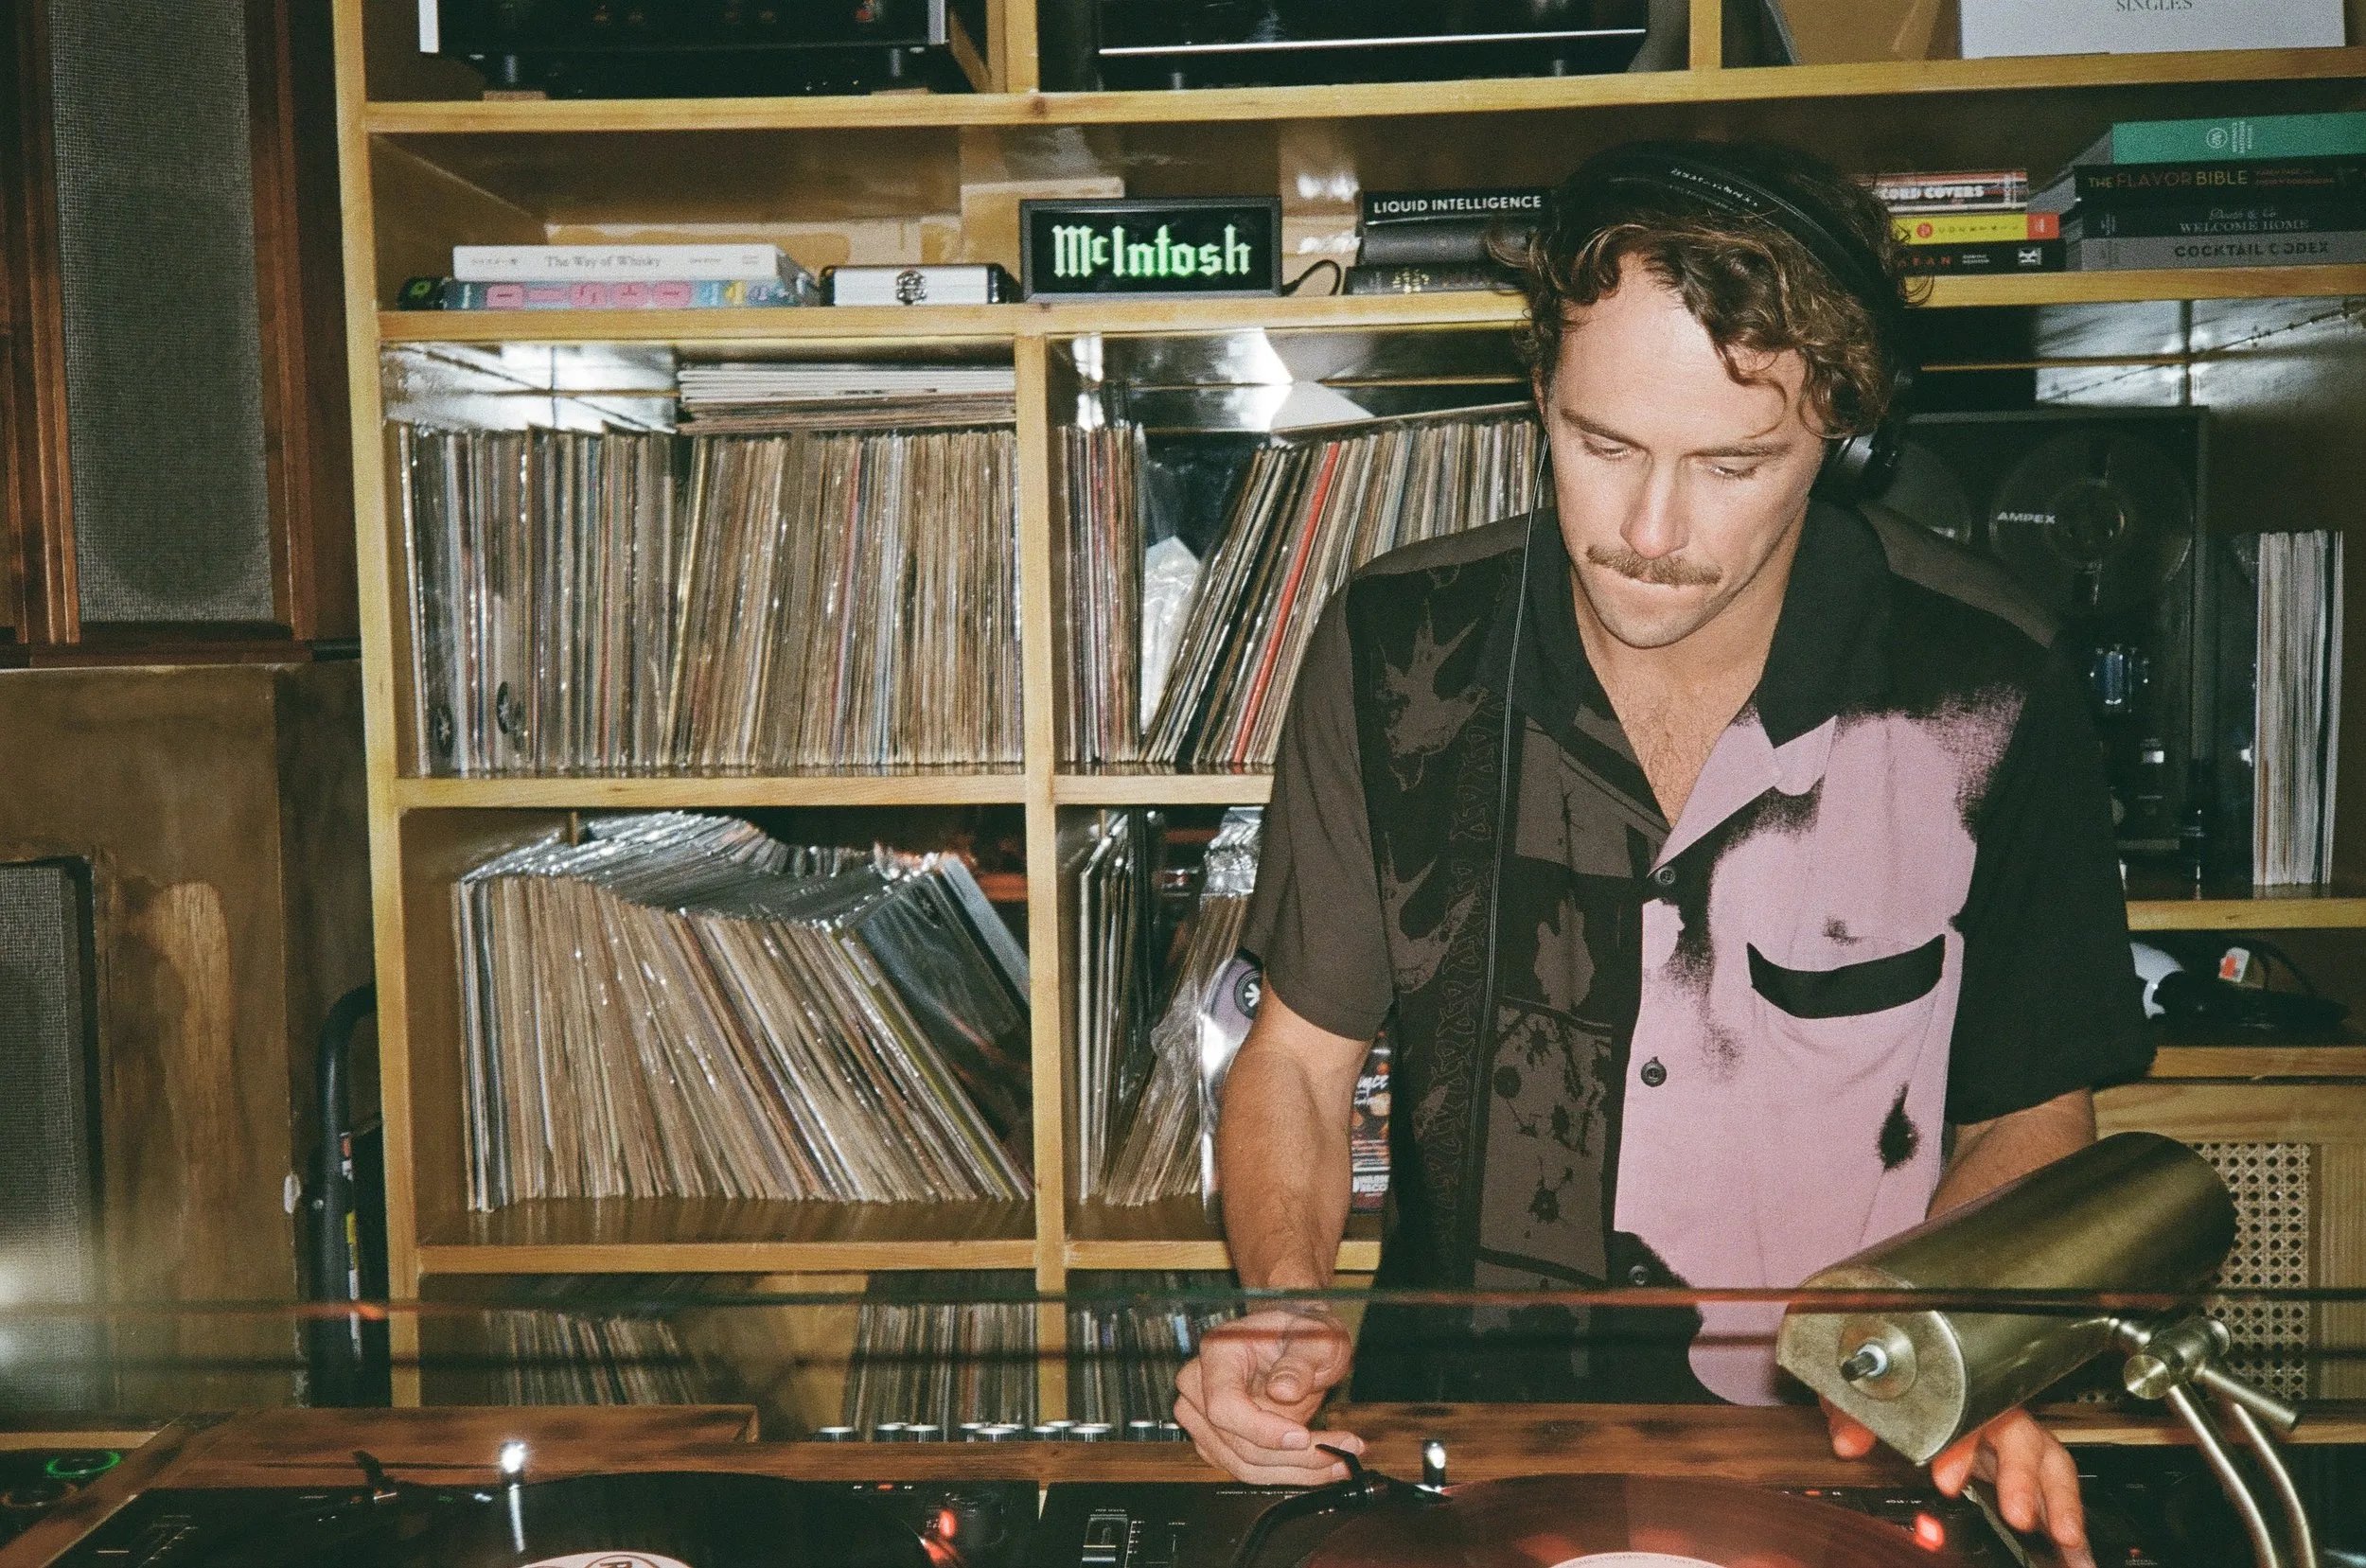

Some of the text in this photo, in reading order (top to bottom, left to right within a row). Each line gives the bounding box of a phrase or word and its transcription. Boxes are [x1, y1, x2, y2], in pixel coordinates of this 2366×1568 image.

[2116, 0, 2193, 11] SINGLES
[2088, 177, 2113, 188] THE
[2114, 171, 2192, 188] FLAVOR
[2196, 170, 2248, 186] BIBLE
[1373, 195, 1542, 214] LIQUID INTELLIGENCE
[2179, 219, 2309, 234] WELCOME HOME
[1051, 223, 1252, 278] McIntosh
[2174, 244, 2263, 257] COCKTAIL
[545, 255, 662, 269] The Way of Whisky
[1996, 511, 2056, 524] AMPEX
